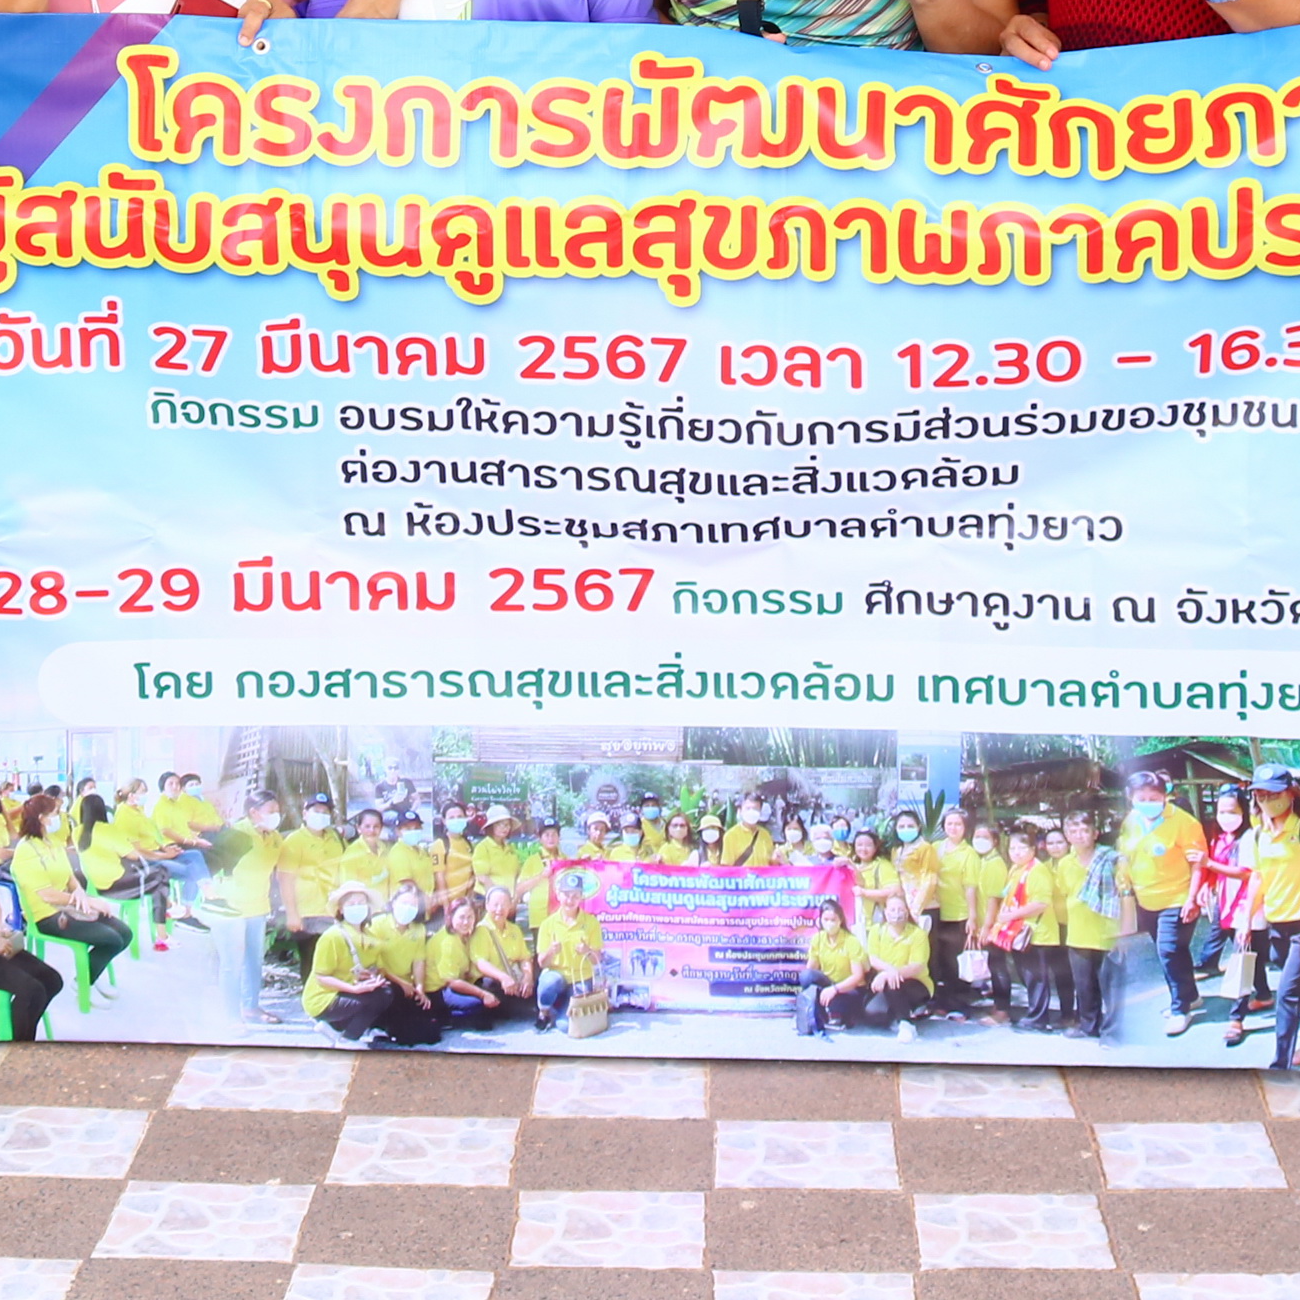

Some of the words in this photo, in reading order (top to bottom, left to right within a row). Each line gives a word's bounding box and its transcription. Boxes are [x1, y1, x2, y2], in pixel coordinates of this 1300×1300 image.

[153, 326, 227, 372] 27
[261, 318, 485, 376] มีนาคม
[519, 334, 687, 383] 2567
[721, 345, 862, 389] เวลา
[898, 340, 1081, 389] 12.30
[150, 388, 320, 430] กิจกรรม
[340, 390, 1298, 452] อบรมให้ความรู้เกี่ยวกับการมีส่วนร่วมของชุมชน
[340, 451, 1020, 501] ต่องานสาธารณสุขและสิ่งแวดล้อม
[343, 512, 386, 536] ณ
[406, 497, 1123, 551] ห้องประชุมสภาเทศบาลตำบลทุ่งยาว
[234, 556, 455, 612] มีนาคม
[490, 567, 655, 612] 2567
[673, 581, 843, 615] กิจกรรม
[865, 580, 1091, 631] ศึกษาดูงาน
[1113, 596, 1155, 623] ณ
[133, 662, 212, 699] โดย
[237, 652, 894, 710] กองสาธารณสุขและสิ่งแวดล้อม
